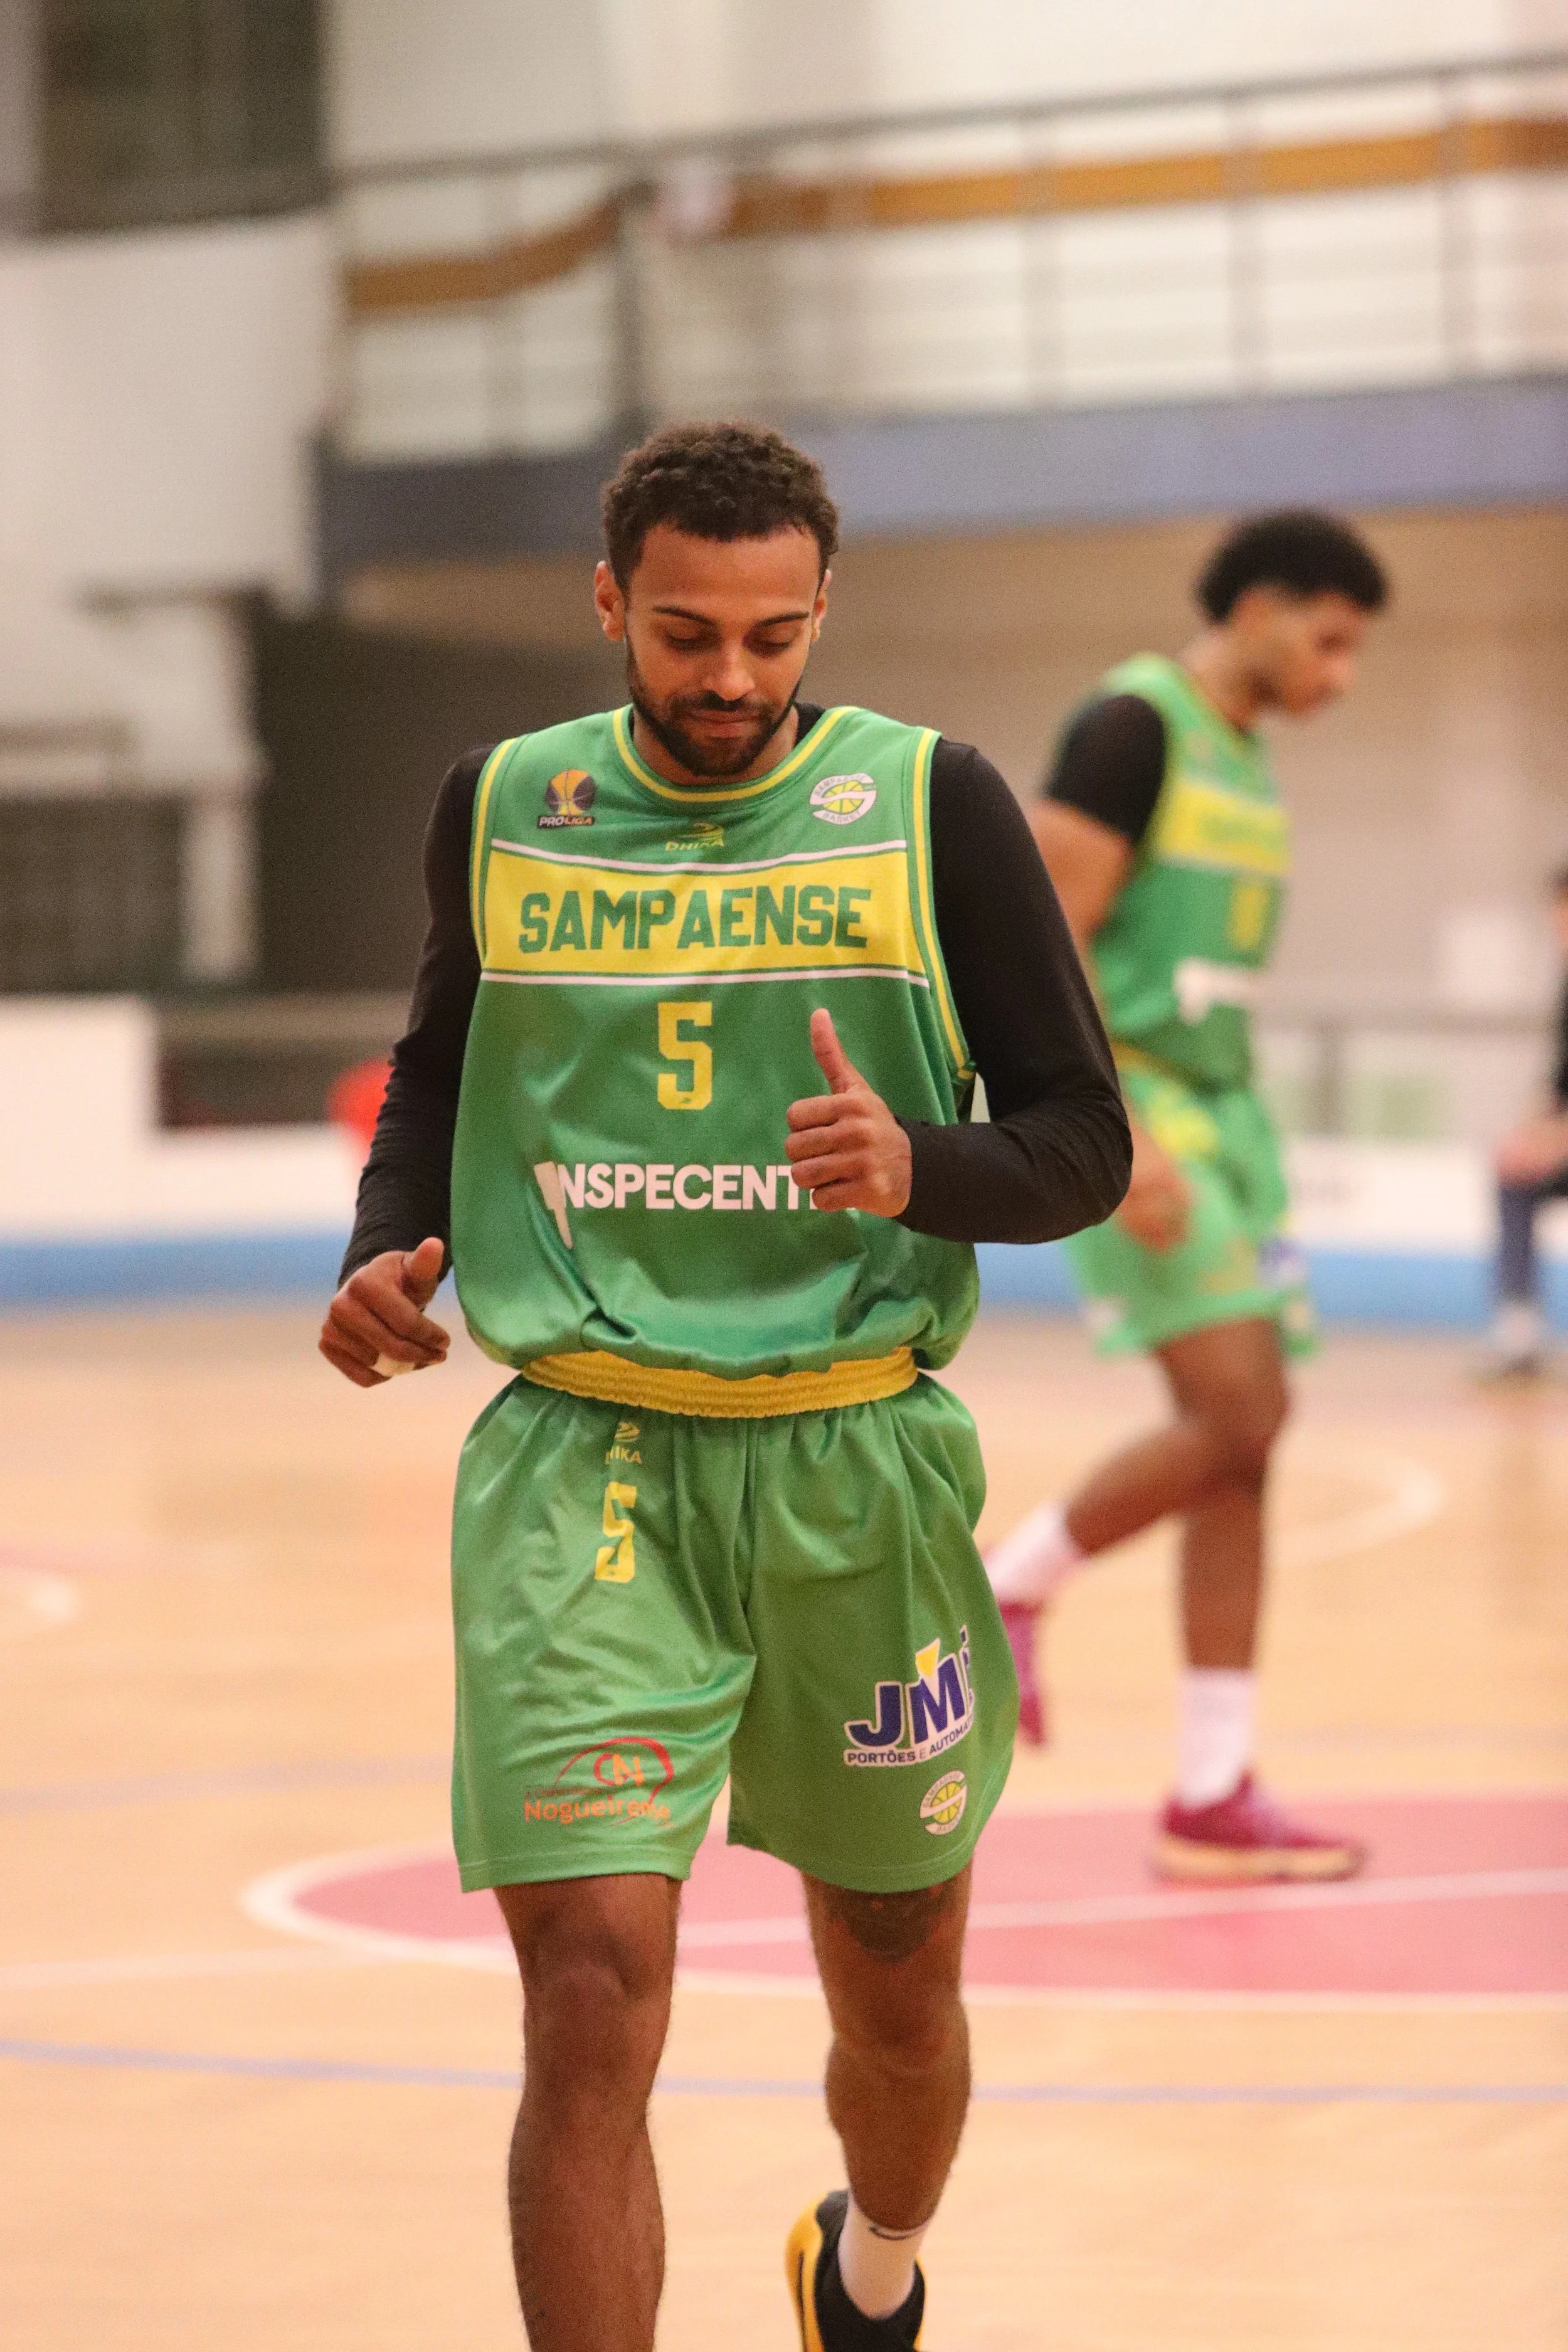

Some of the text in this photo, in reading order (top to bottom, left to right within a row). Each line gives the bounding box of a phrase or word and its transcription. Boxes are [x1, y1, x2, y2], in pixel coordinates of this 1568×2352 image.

[539, 816, 593, 827] PROLIGA
[518, 885, 872, 954] SAMPAENSE
[657, 1002, 712, 1110] 5
[595, 1481, 637, 1583] 5
[847, 1749, 916, 1764] PORTÕES
